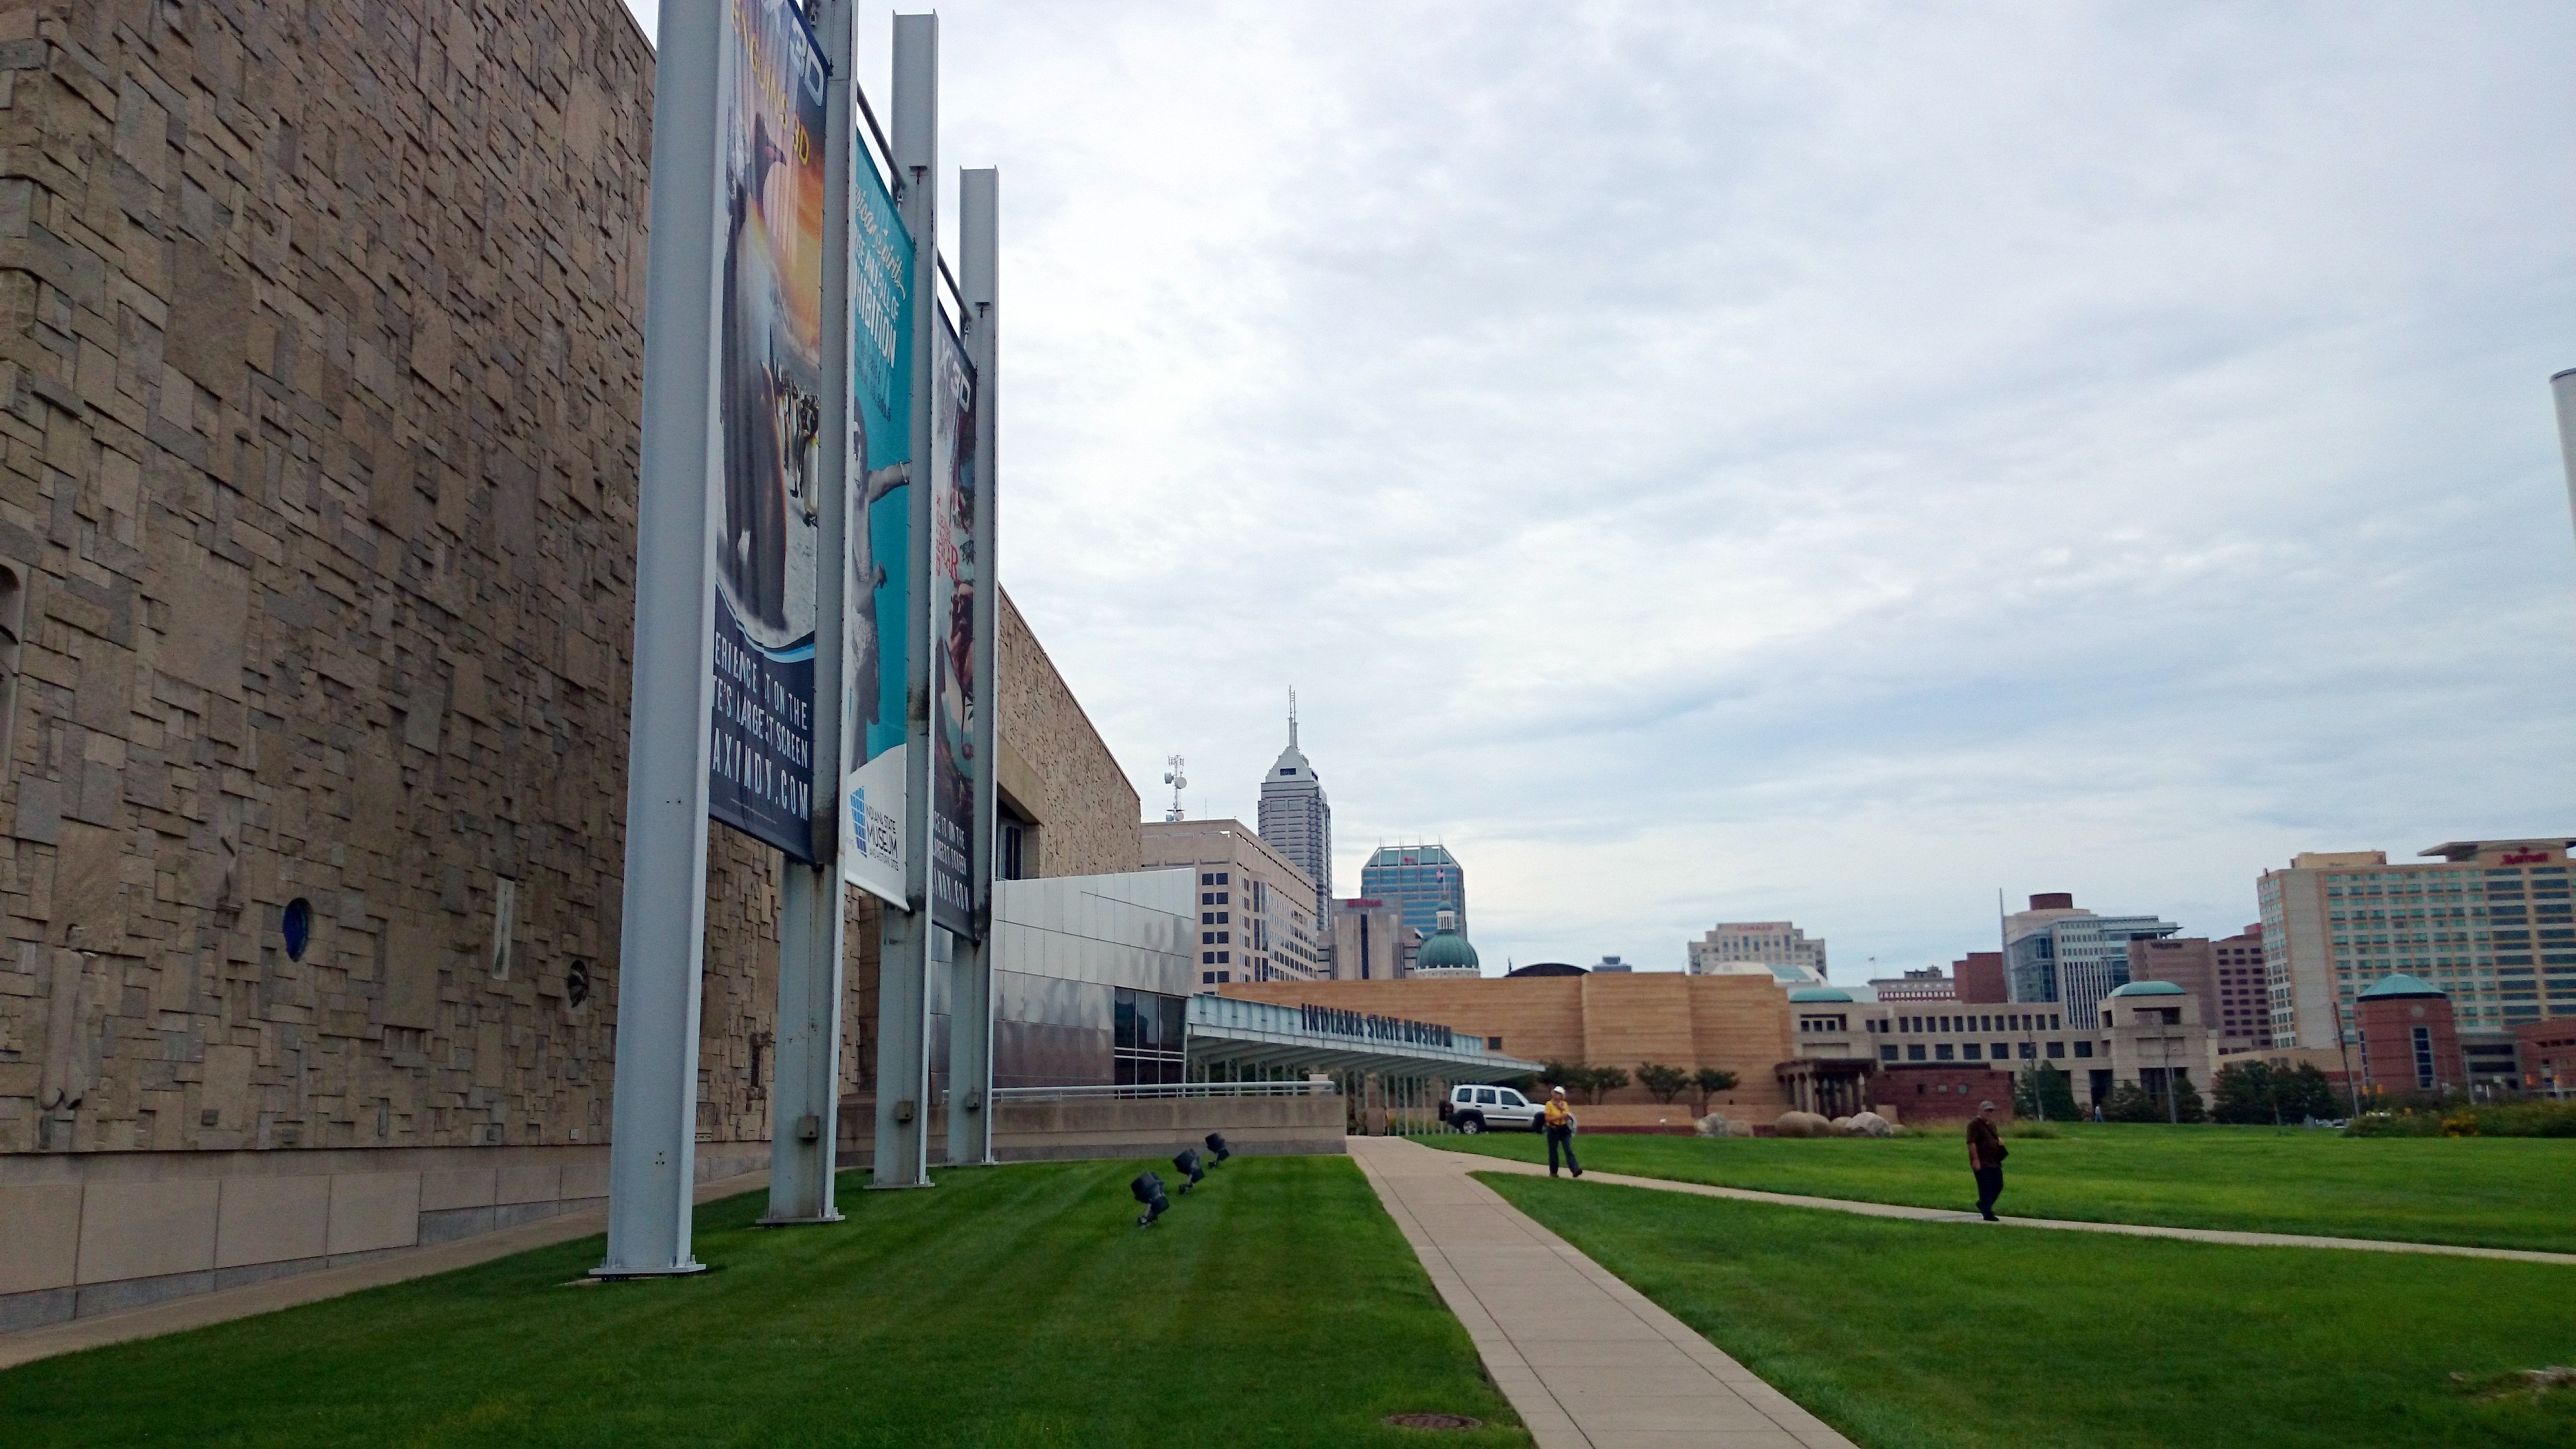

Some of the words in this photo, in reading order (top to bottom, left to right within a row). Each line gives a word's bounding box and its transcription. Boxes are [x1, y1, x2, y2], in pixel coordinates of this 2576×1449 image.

[790, 17, 824, 107] 3D
[864, 249, 878, 289] AND
[855, 259, 897, 369] HIBITION
[951, 360, 971, 413] 3D
[773, 680, 786, 716] ON
[788, 692, 808, 731] THE
[776, 721, 808, 769] SCREEN
[866, 821, 898, 859] MUSEUM
[956, 826, 965, 851] THE
[932, 867, 969, 912] INDY.COM
[1301, 1002, 1364, 1038] INDIANA
[1366, 1014, 1405, 1041] STATE
[1403, 1018, 1452, 1048] MUSEUM
